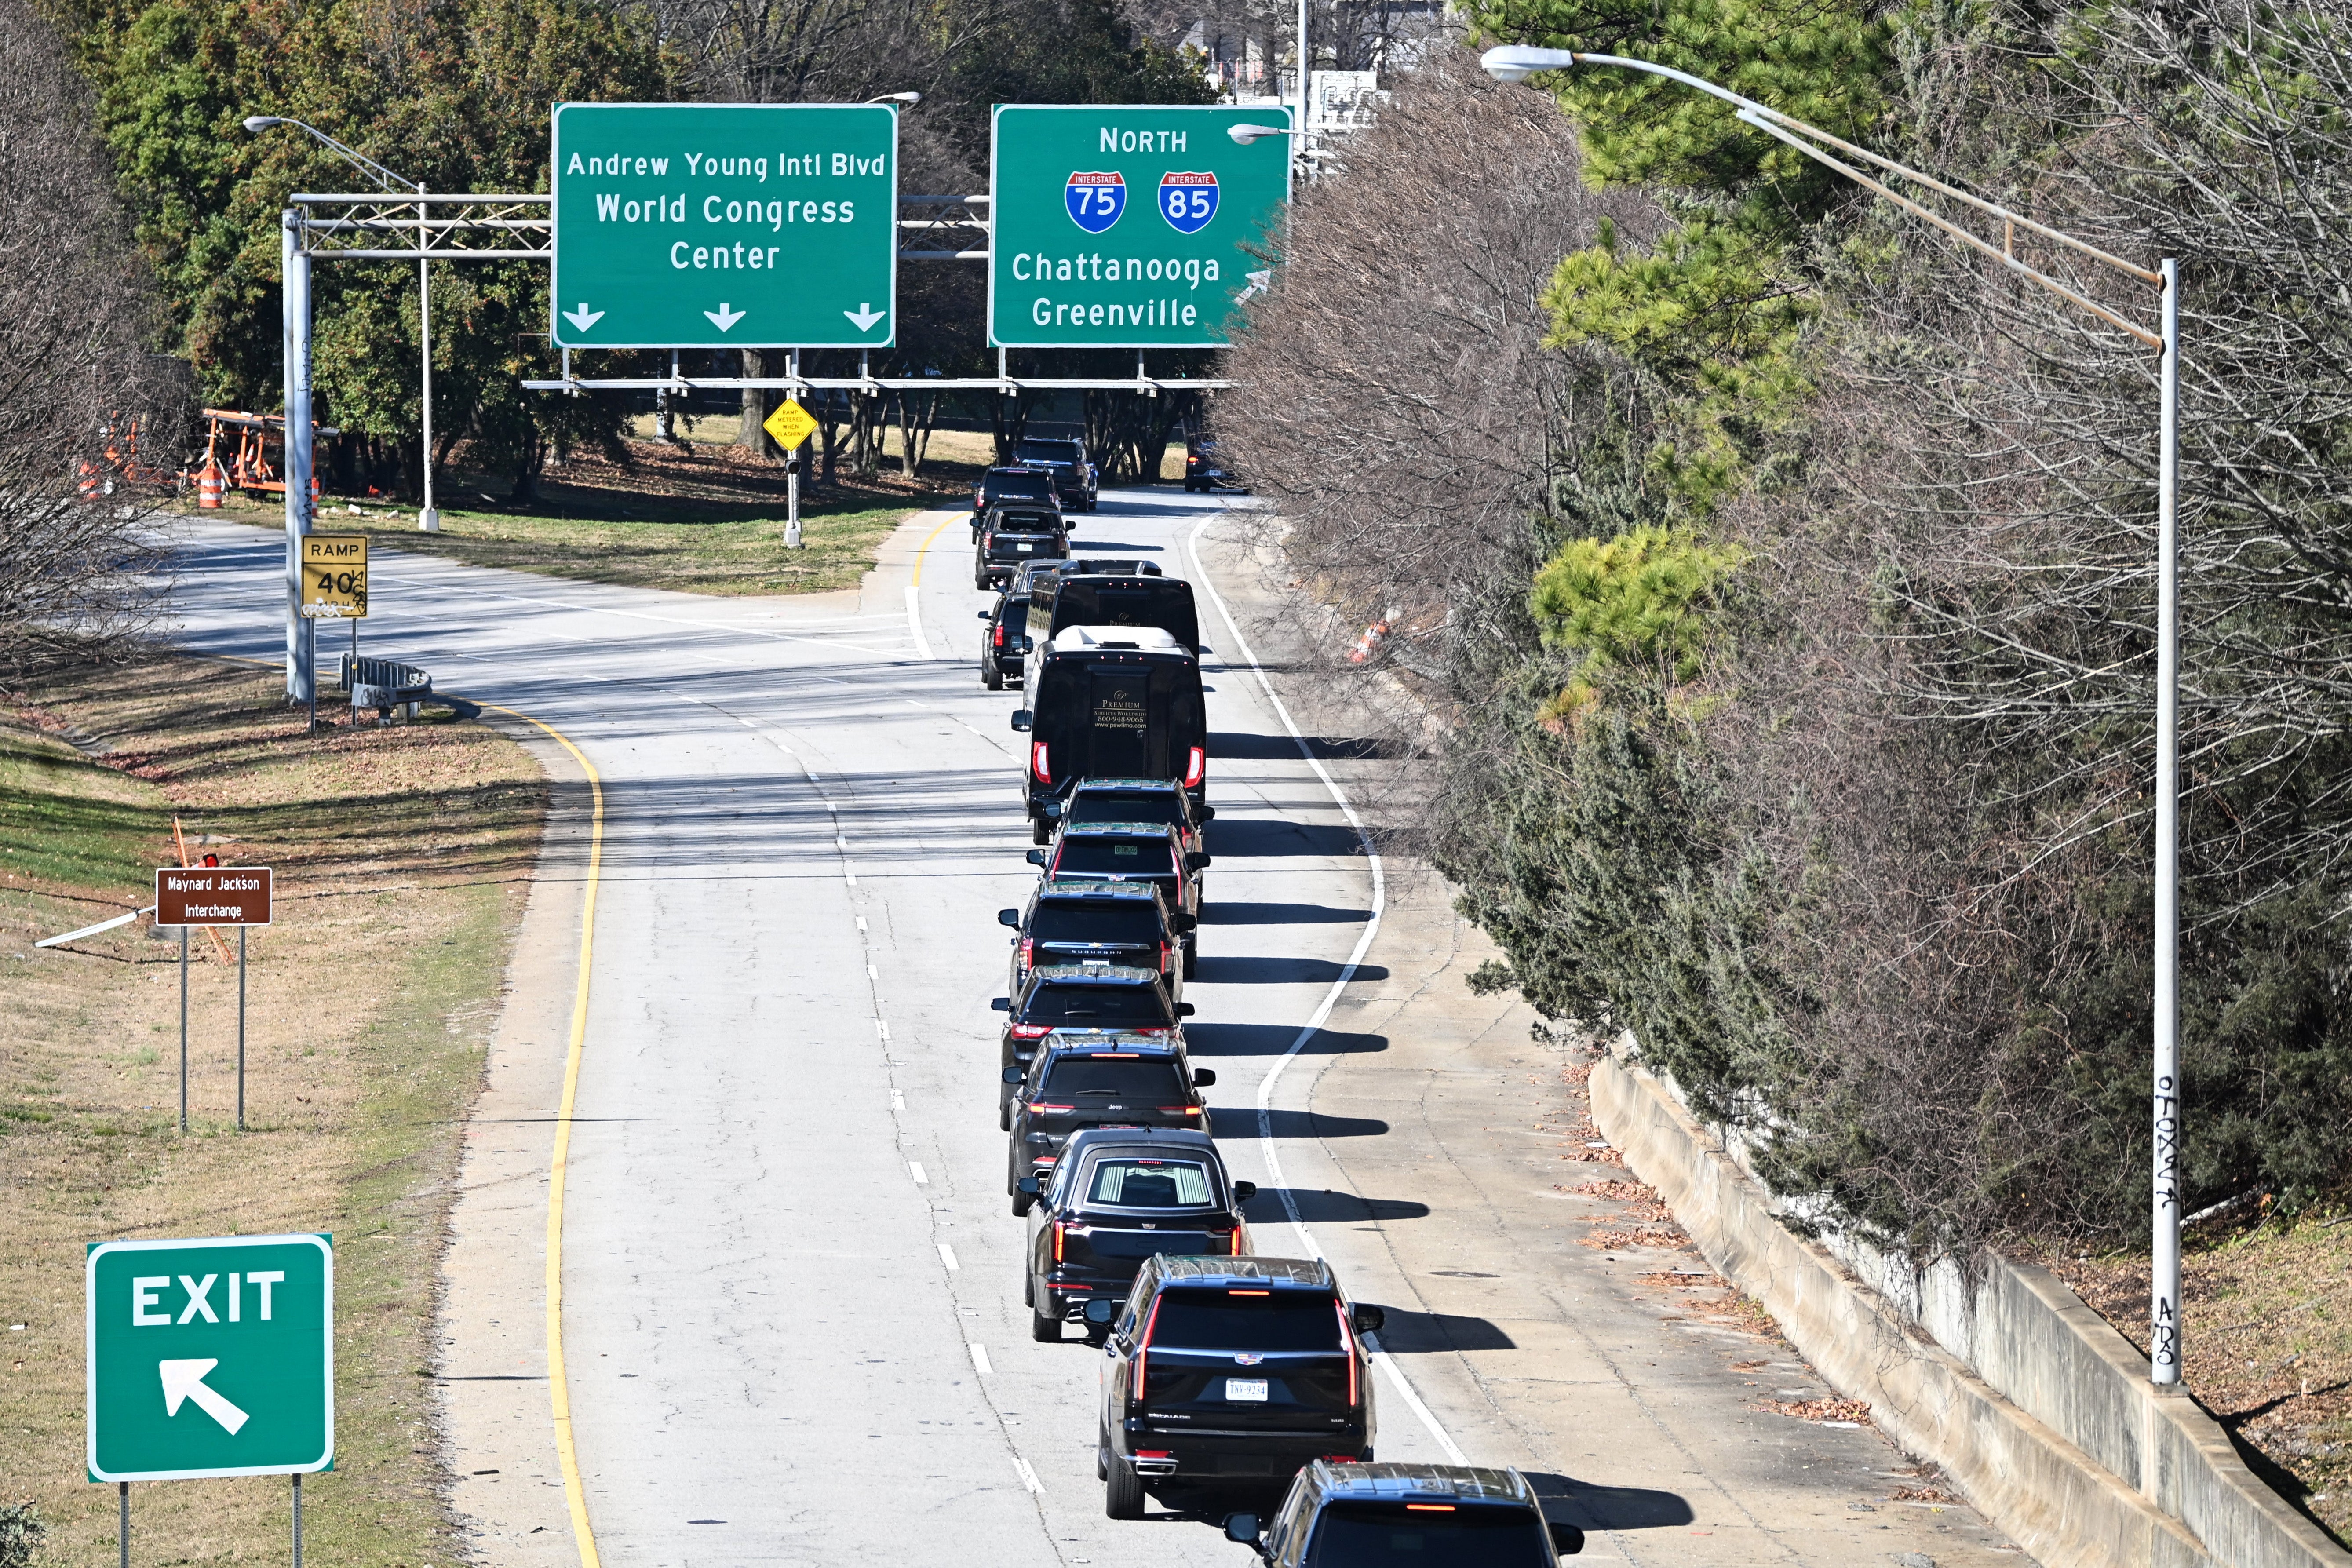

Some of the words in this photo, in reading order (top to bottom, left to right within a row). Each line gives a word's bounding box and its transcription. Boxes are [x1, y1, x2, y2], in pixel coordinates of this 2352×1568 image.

[1100, 127, 1186, 152] NORTH
[567, 152, 669, 175] Andrew
[684, 153, 767, 183] Young
[780, 153, 820, 176] Intl
[832, 153, 885, 176] Blvd
[596, 193, 685, 222] World
[703, 195, 854, 232] Congress
[1075, 187, 1116, 215] 75
[1168, 190, 1210, 219] 85
[671, 241, 780, 269] Center
[1013, 252, 1219, 290] Chattanooga
[1032, 297, 1196, 326] Greenville
[311, 544, 359, 556] RAMP
[317, 572, 352, 594] 40
[1102, 700, 1140, 708] PREMIUM
[168, 876, 212, 893] Maynard
[218, 876, 259, 890] Jackson
[185, 904, 242, 919] Interchange
[133, 1270, 284, 1326] EXIT
